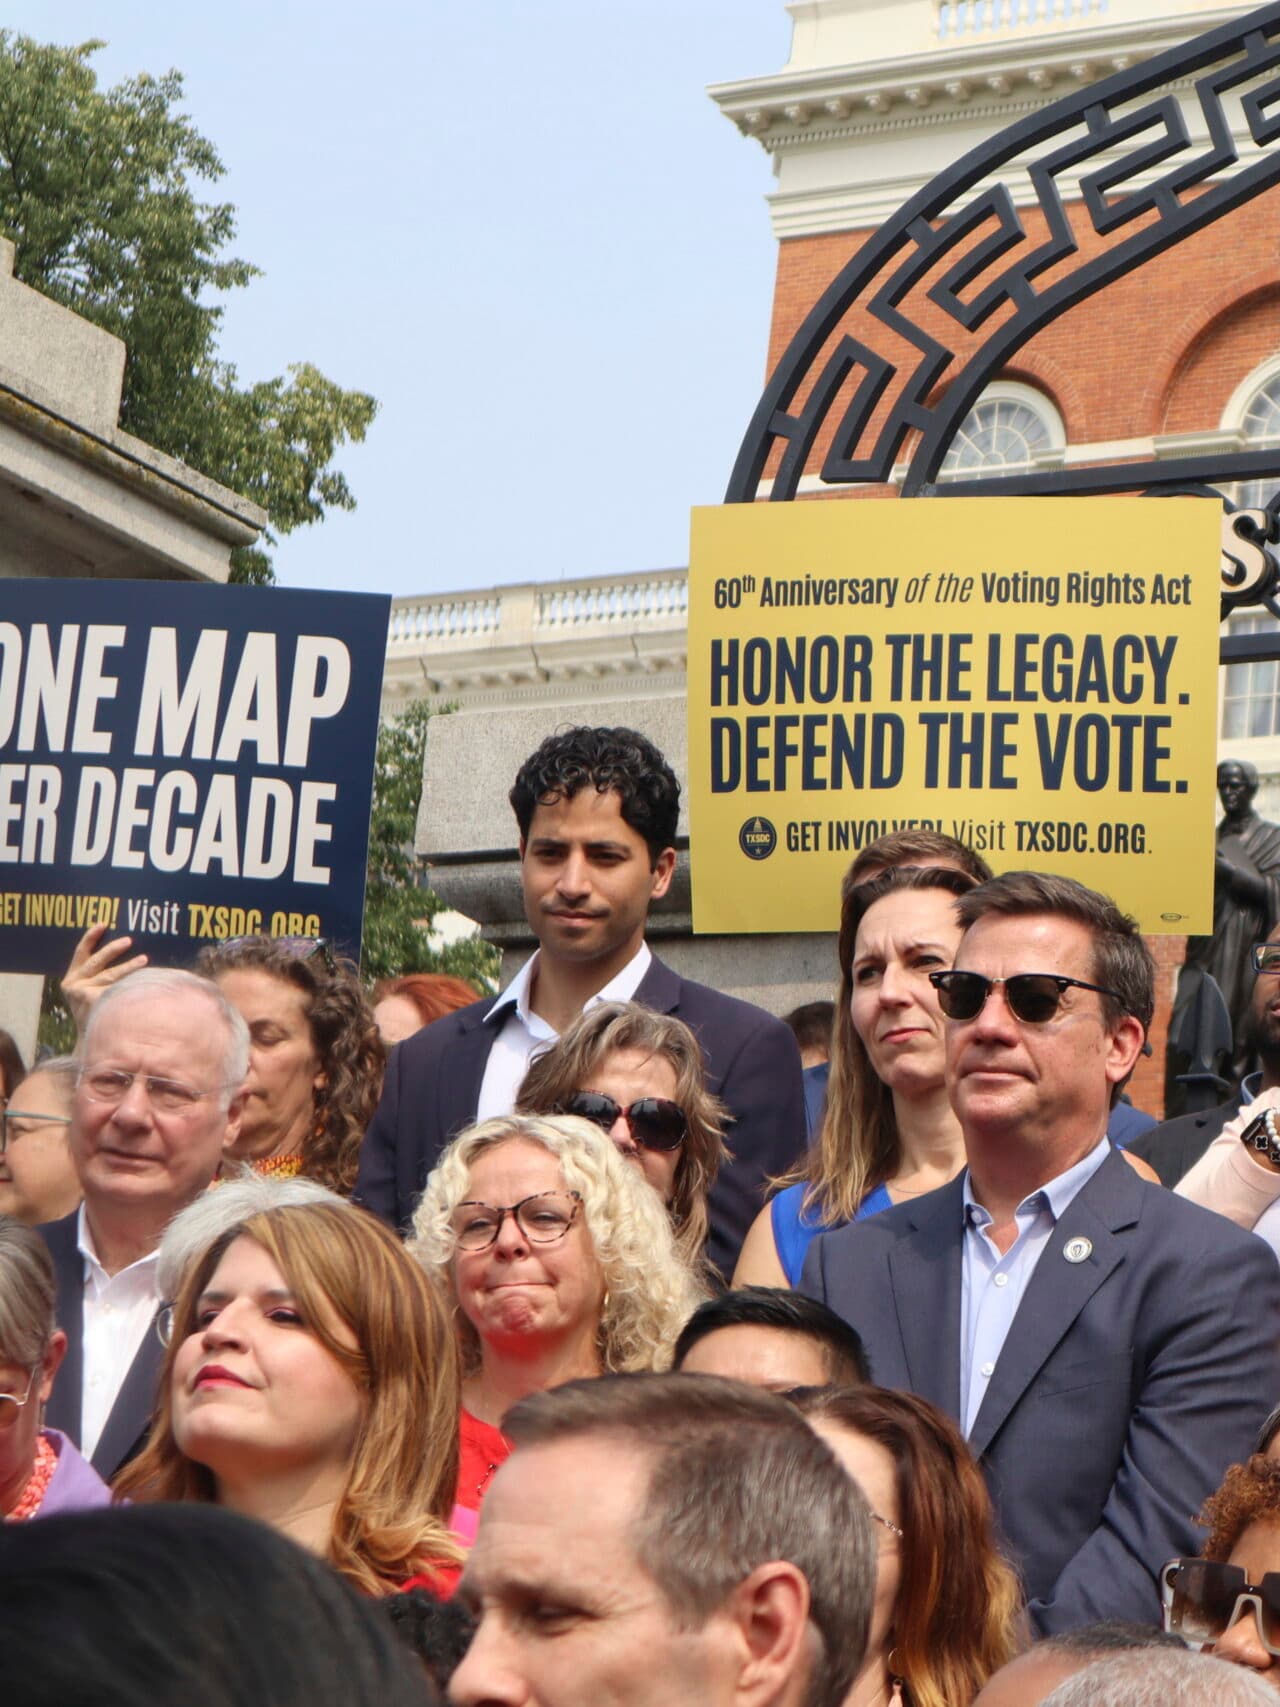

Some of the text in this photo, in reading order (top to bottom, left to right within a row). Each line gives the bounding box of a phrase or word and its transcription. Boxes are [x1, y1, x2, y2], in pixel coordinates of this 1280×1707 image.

[714, 571, 1192, 609] 60th Anniversary of the Voting Rights Act
[132, 627, 352, 768] MAP
[710, 633, 1190, 706] HONOR THE LEGACY.
[711, 712, 1189, 793] DEFEND THE VOTE.
[70, 764, 337, 885] DECADE
[745, 833, 770, 844] TXSDC
[786, 821, 822, 852] GET
[1014, 820, 1152, 854] TXSDC.ORG.
[25, 893, 120, 930] INVOLVED!
[127, 899, 180, 934] Visit
[187, 903, 320, 938] TXSDCORG
